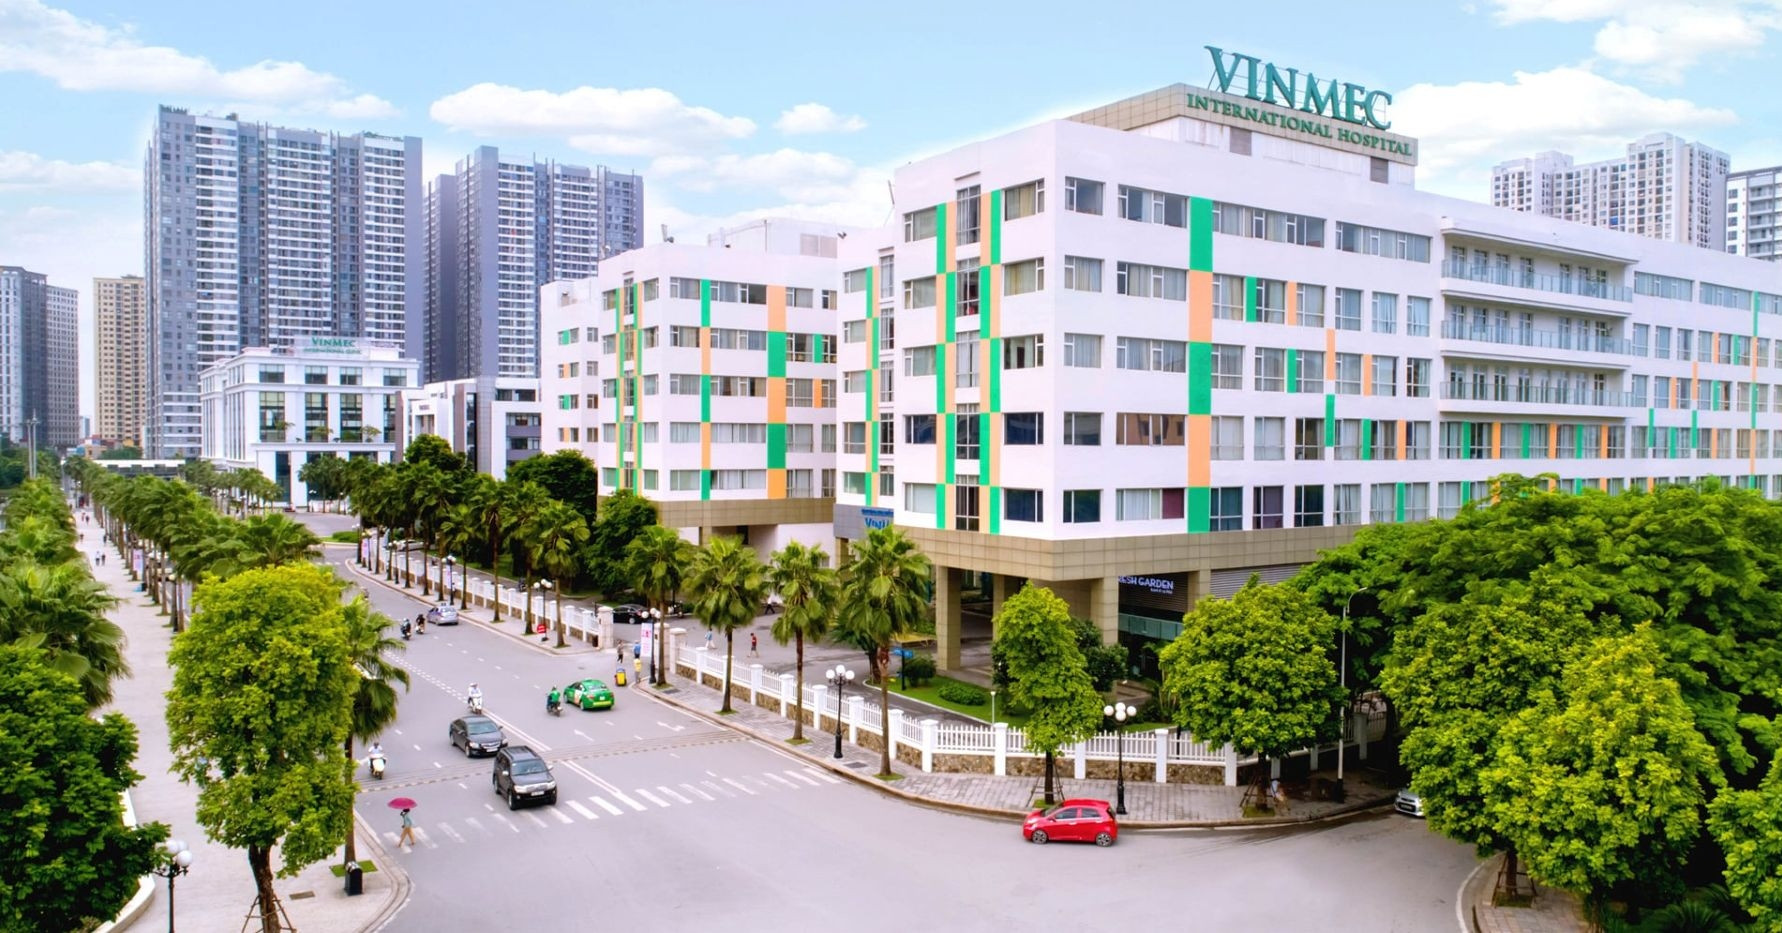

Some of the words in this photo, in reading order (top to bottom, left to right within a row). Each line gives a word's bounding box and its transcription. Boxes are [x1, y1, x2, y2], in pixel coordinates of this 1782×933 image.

[1204, 45, 1392, 131] VINMEC
[1186, 93, 1333, 139] INTERNATIONAL
[1337, 127, 1413, 156] HOSPITAL
[1138, 577, 1173, 589] GARDEN
